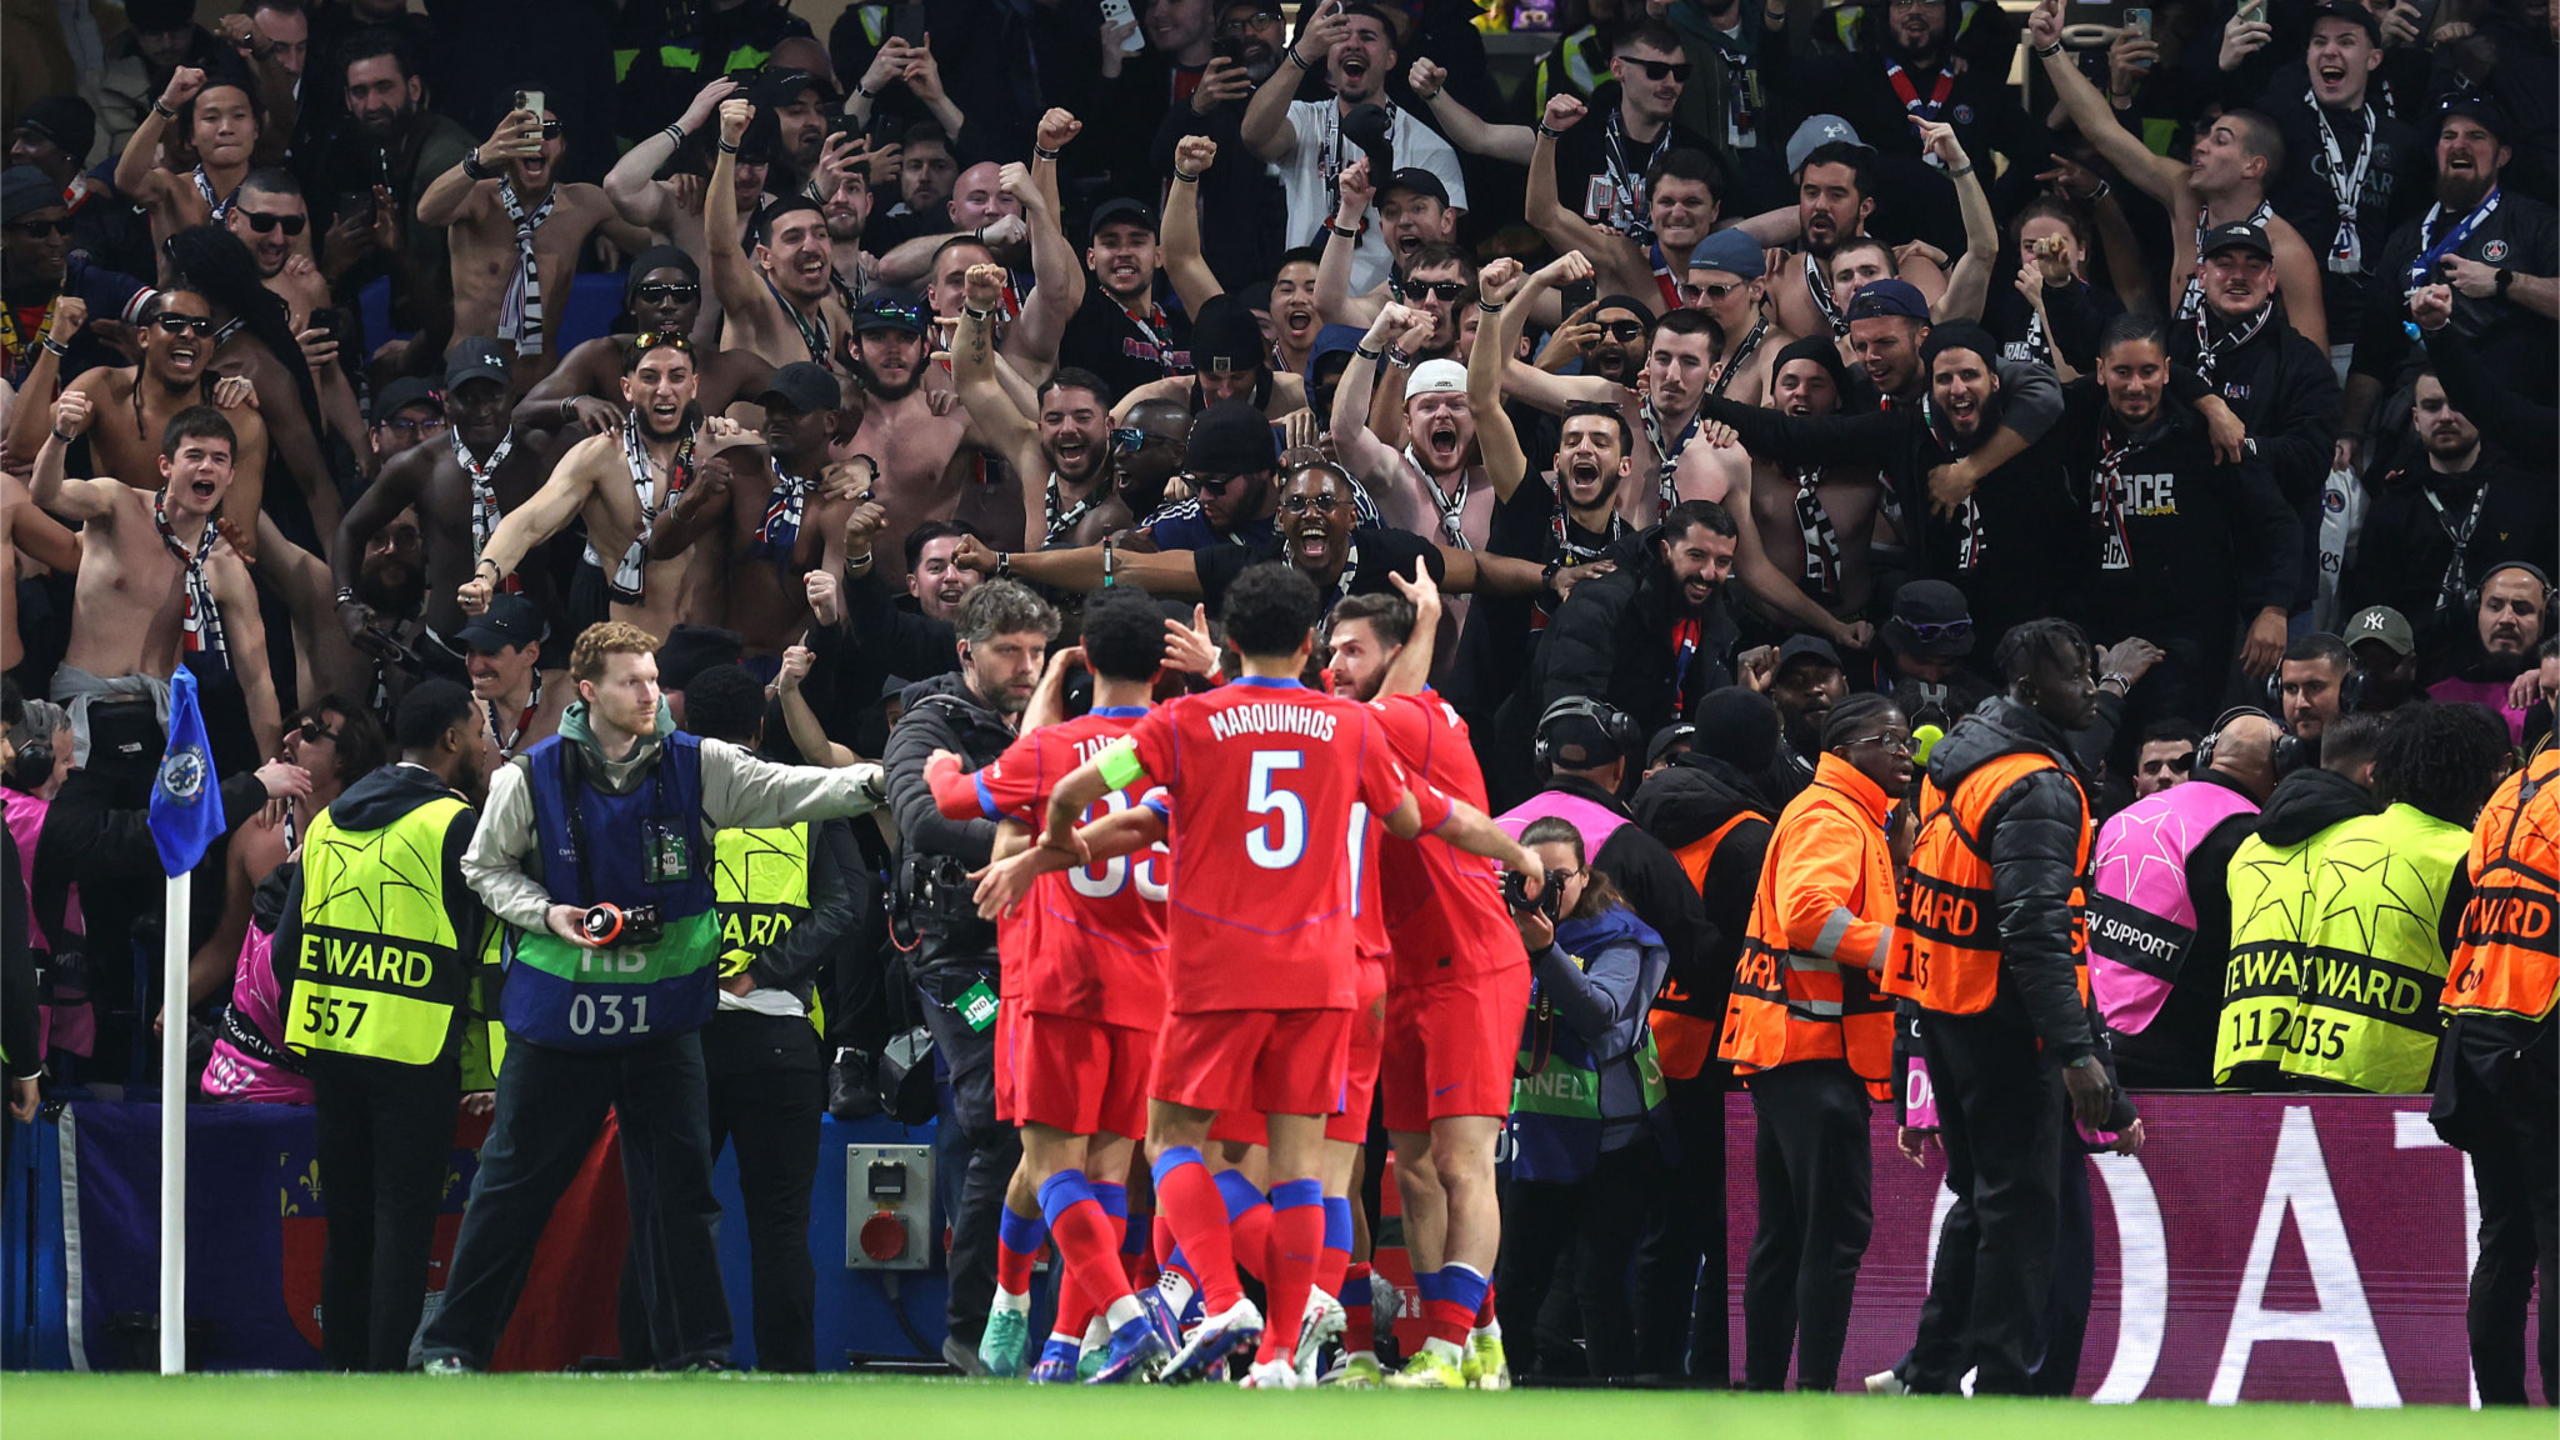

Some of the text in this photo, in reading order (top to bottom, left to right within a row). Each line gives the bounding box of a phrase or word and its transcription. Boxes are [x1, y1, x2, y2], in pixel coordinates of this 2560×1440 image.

[1208, 704, 1337, 742] MARQUINHOS
[1245, 749, 1308, 870] 5
[2101, 918, 2180, 962] SUPPORT
[303, 994, 368, 1039] 557
[569, 993, 651, 1036] 031
[2233, 1007, 2291, 1052] 112
[2286, 1015, 2351, 1061] 035
